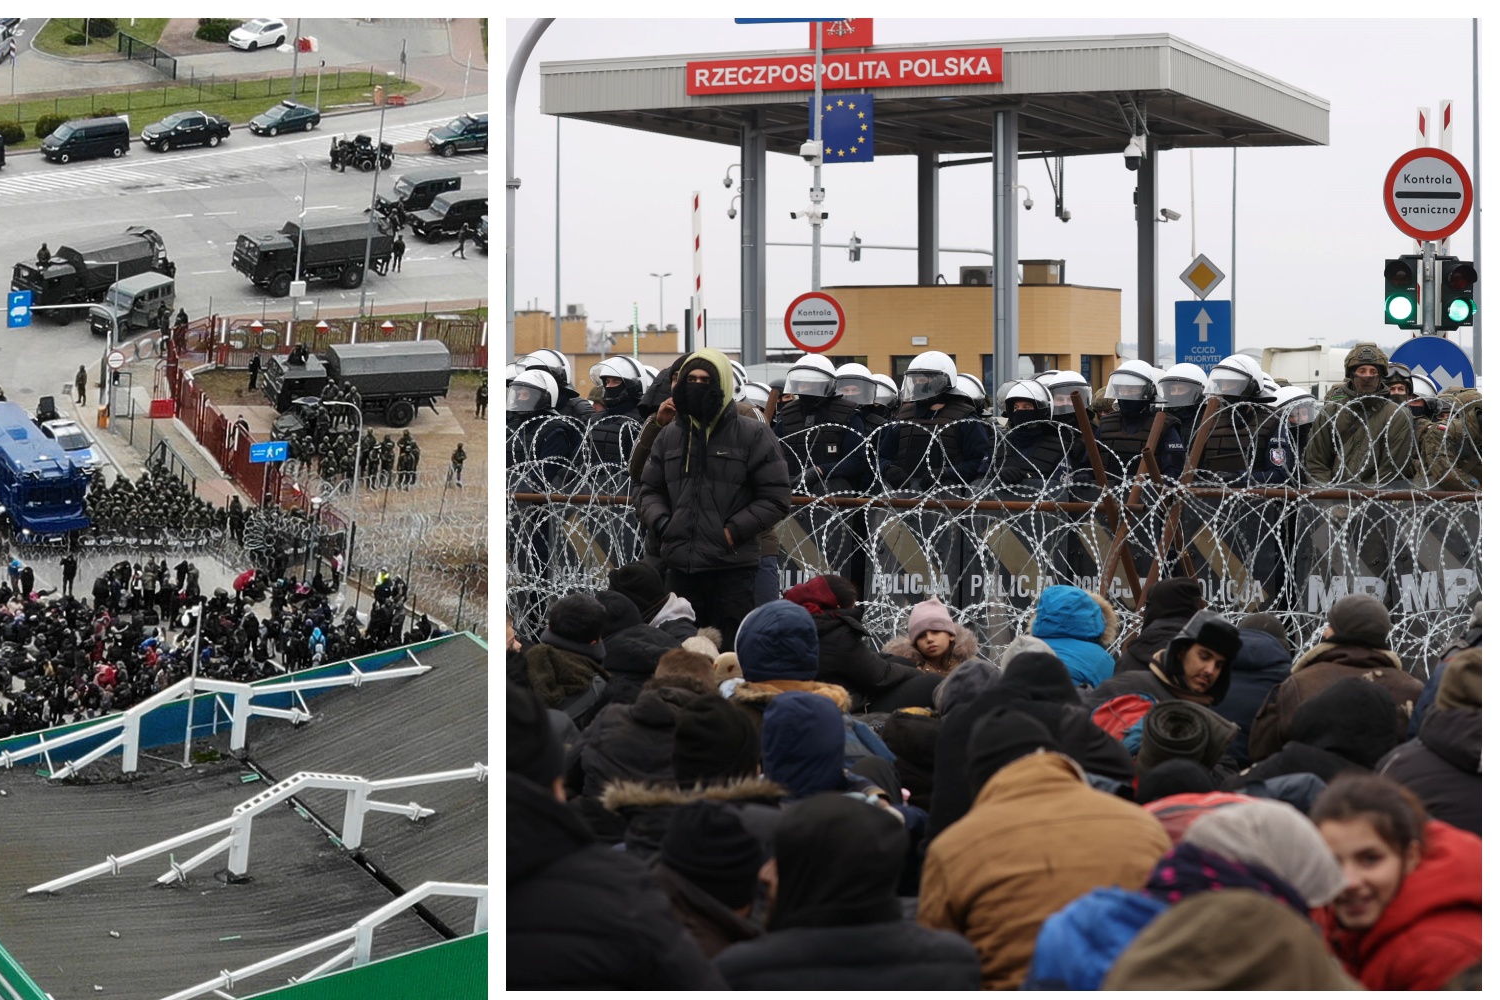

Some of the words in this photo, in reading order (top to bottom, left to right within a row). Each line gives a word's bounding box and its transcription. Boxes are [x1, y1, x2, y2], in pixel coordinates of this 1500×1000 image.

[694, 59, 891, 88] RZECZPOSPOLITA
[899, 56, 992, 78] POLSKA
[1403, 173, 1453, 184] Kontrola
[1400, 204, 1456, 216] graniczna
[795, 329, 834, 338] graniczna
[1191, 346, 1216, 354] CC/CD
[1184, 355, 1222, 363] PRIORYTET
[871, 573, 952, 595] POLICJA
[1401, 568, 1478, 612] MP
